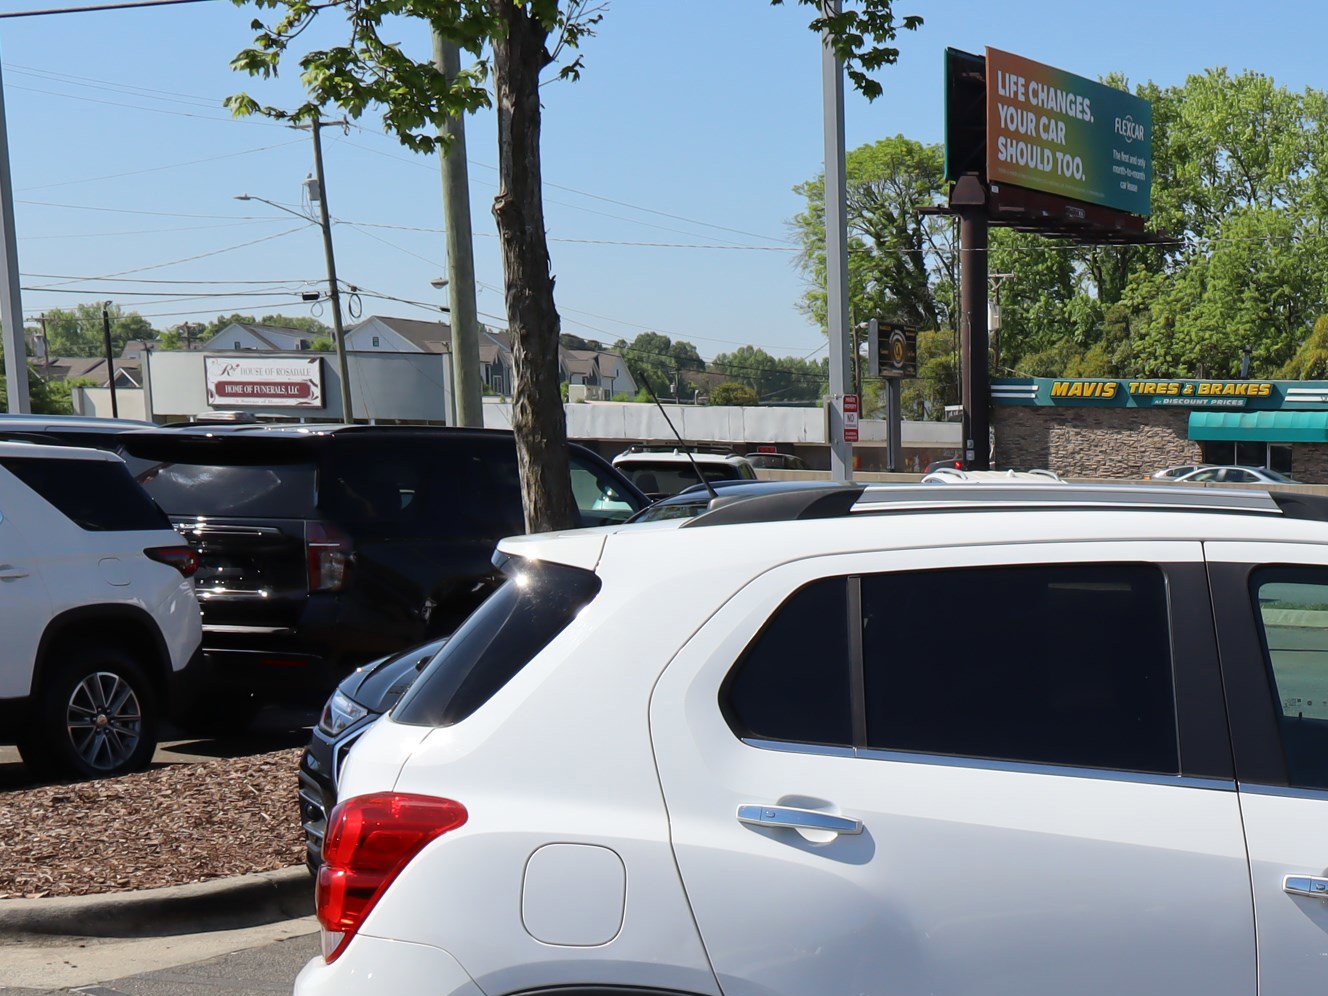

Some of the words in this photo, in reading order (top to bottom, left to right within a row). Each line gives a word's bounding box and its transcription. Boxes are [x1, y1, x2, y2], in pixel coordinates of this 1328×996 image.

[998, 70, 1025, 101] LIFE
[1029, 81, 1094, 123] CHANGES.
[998, 103, 1036, 137] YOUR
[1039, 116, 1066, 145] CAR
[1115, 117, 1144, 141] FLEXCAR
[997, 136, 1053, 172] SHOULD
[1056, 152, 1086, 181] TOO.
[240, 367, 262, 376] HOUSE
[265, 367, 275, 376] OF
[225, 384, 243, 394] HOME
[244, 385, 253, 394] OF
[288, 385, 300, 395] LLC
[1051, 382, 1117, 398] MAVIS
[1129, 382, 1181, 395] TIRES
[1183, 383, 1194, 396] &
[1197, 383, 1272, 396] BRAKES
